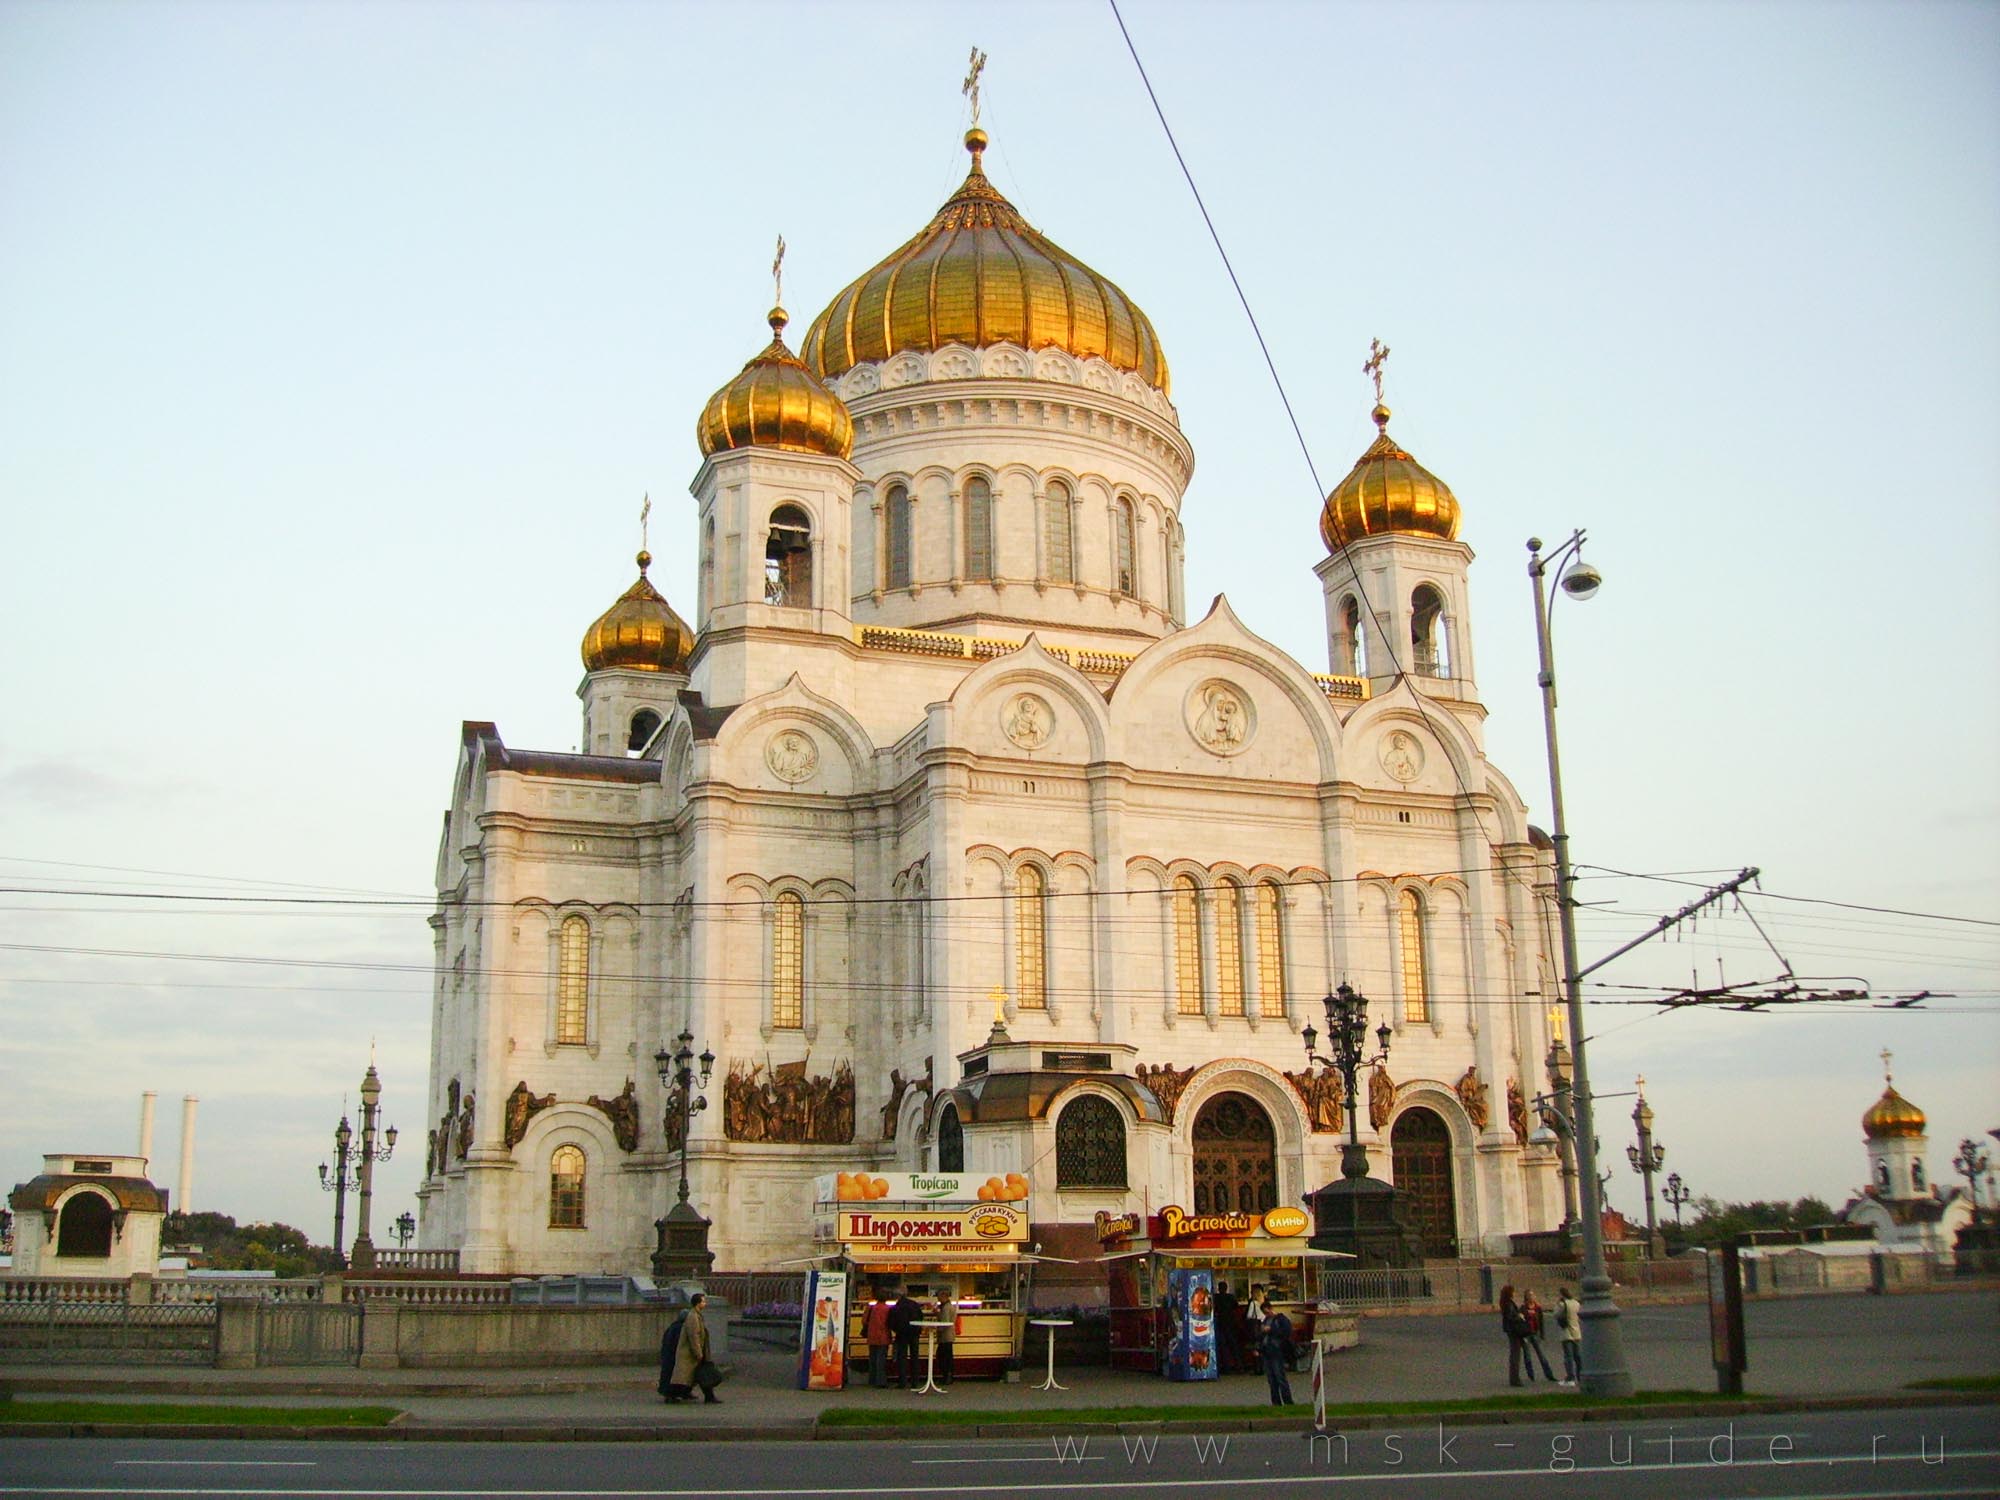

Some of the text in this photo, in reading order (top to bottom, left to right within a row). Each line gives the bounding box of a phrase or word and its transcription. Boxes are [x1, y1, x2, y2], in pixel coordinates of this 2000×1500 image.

[909, 1174, 959, 1191] Tropicana
[968, 1207, 1018, 1225] РУССКАЯ КУХНЯ
[1163, 1206, 1250, 1238] Распекай
[1268, 1216, 1306, 1229] БЛИНЫ
[849, 1214, 962, 1245] Пирожки
